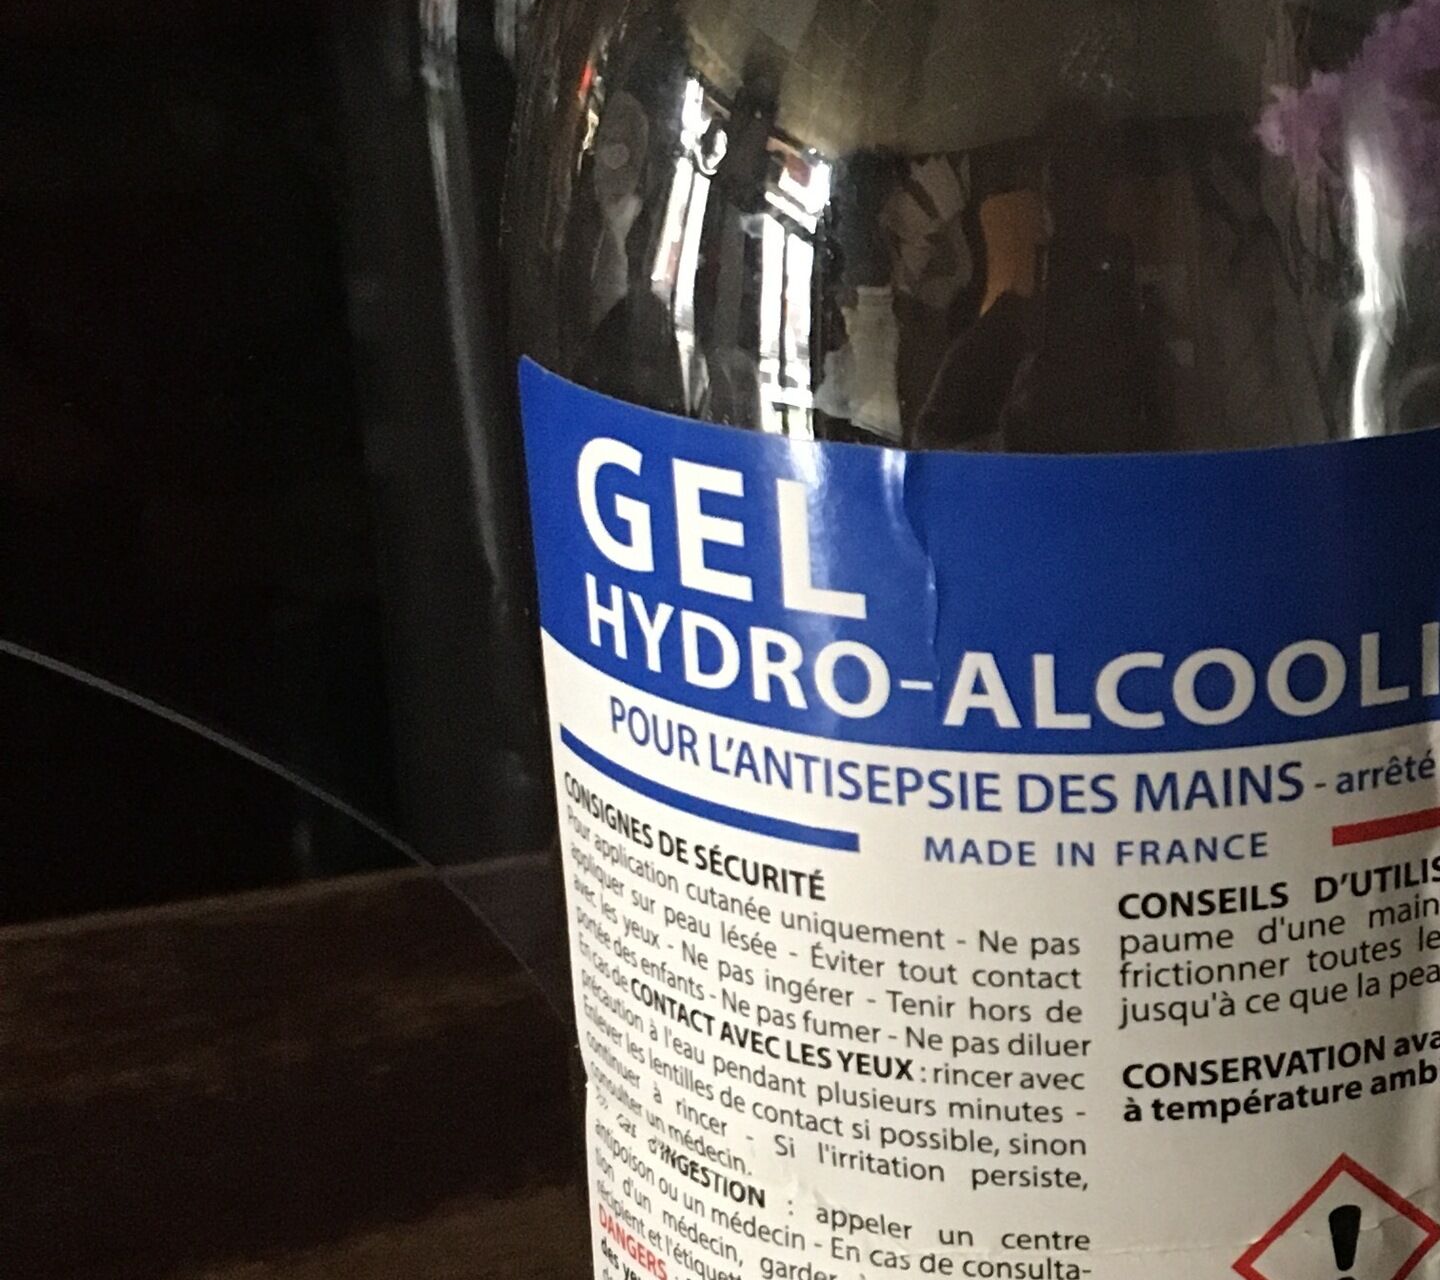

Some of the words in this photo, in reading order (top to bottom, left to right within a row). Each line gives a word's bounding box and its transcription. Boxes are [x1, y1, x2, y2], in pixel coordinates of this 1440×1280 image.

[576, 437, 867, 620] GEL
[610, 695, 699, 766] POUR
[709, 732, 1002, 813] L'ANTISEPSIE
[1018, 772, 1118, 814] DES
[1135, 762, 1304, 813] MAINS
[1336, 748, 1435, 794] arrêté
[565, 772, 654, 848] CONSIGNES
[659, 829, 689, 865] DE
[694, 844, 826, 901] SÉCURITÉ
[924, 837, 1036, 866] MADE
[1056, 841, 1095, 867] IN
[1116, 832, 1268, 866] FRANCE
[687, 881, 771, 924] cutanée
[781, 910, 946, 951] uniquement
[979, 930, 1018, 954] Ne
[1031, 936, 1081, 960] pas
[1118, 882, 1289, 919] CONSEILS
[1120, 929, 1234, 961] paume
[1258, 915, 1346, 945] d'une
[1369, 894, 1439, 929] main
[665, 904, 711, 937] peau
[722, 921, 777, 959] lésée
[811, 942, 885, 978] Éviter
[899, 961, 957, 985] tout
[972, 968, 1081, 989] contact
[1120, 956, 1290, 988] frictionner
[1307, 937, 1402, 973] toutes
[641, 957, 705, 1001] enfants
[803, 1010, 881, 1044] fumer
[906, 1027, 943, 1050] Ne
[952, 1035, 999, 1057] pas
[1008, 1032, 1092, 1057] diluer
[718, 960, 754, 986] pas
[765, 971, 854, 1007] ingérer
[886, 990, 955, 1018] Tenir
[970, 997, 1031, 1021] hors
[1046, 1000, 1082, 1023] de
[1119, 990, 1235, 1029] jusqu'à
[1245, 992, 1280, 1014] ce
[1289, 982, 1349, 1014] que
[1358, 972, 1380, 998] la
[630, 977, 716, 1037] CONTACT
[721, 1021, 781, 1060] AVEC
[786, 1040, 832, 1069] LES
[838, 1049, 915, 1081] YEUX
[933, 1063, 1013, 1088] rincer
[1020, 1072, 1086, 1090] avec
[1123, 1035, 1386, 1089] CONSERVATION
[650, 1048, 714, 1101] lentilles
[753, 1102, 844, 1136] contact
[852, 1120, 870, 1140] si
[880, 1125, 1000, 1156] possible,
[1009, 1133, 1087, 1155] sinon
[713, 1054, 806, 1097] pendant
[818, 1081, 937, 1116] plusieurs
[949, 1098, 1064, 1122] minutes
[1124, 1095, 1142, 1121] à
[1152, 1079, 1362, 1123] température
[775, 1134, 795, 1158] Si
[818, 1142, 945, 1183] l'irritation
[971, 1165, 1088, 1192] persiste,
[663, 1208, 743, 1267] médecin,
[712, 1206, 806, 1250] médecin
[831, 1241, 860, 1263] En
[870, 1249, 910, 1271] cas
[920, 1252, 953, 1276] de
[816, 1206, 912, 1241] appeler
[939, 1228, 974, 1248] un
[1001, 1231, 1091, 1251] centre
